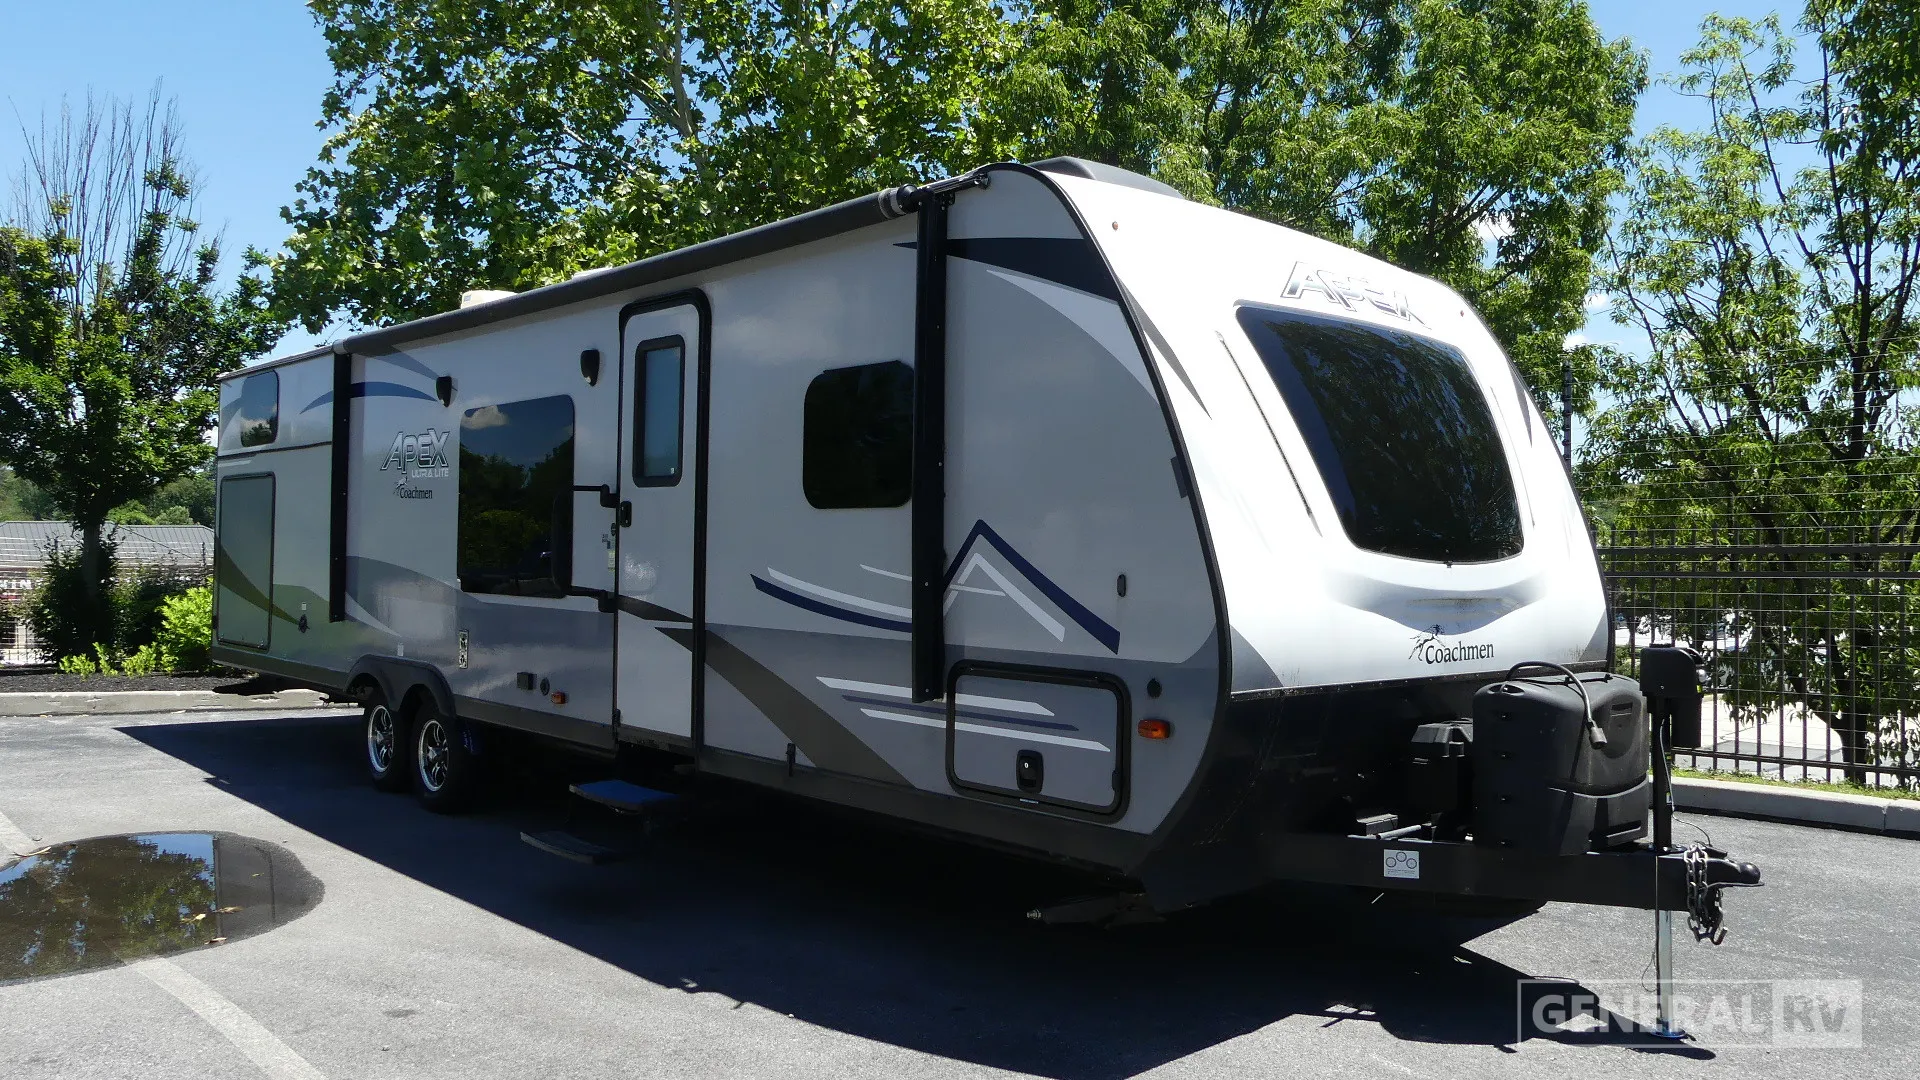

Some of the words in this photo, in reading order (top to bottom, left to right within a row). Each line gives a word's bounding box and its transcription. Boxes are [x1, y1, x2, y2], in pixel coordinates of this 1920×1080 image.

[380, 428, 450, 474] APEX
[434, 468, 449, 478] LITE
[400, 486, 433, 499] Coachmen
[1425, 641, 1494, 664] Coachmen
